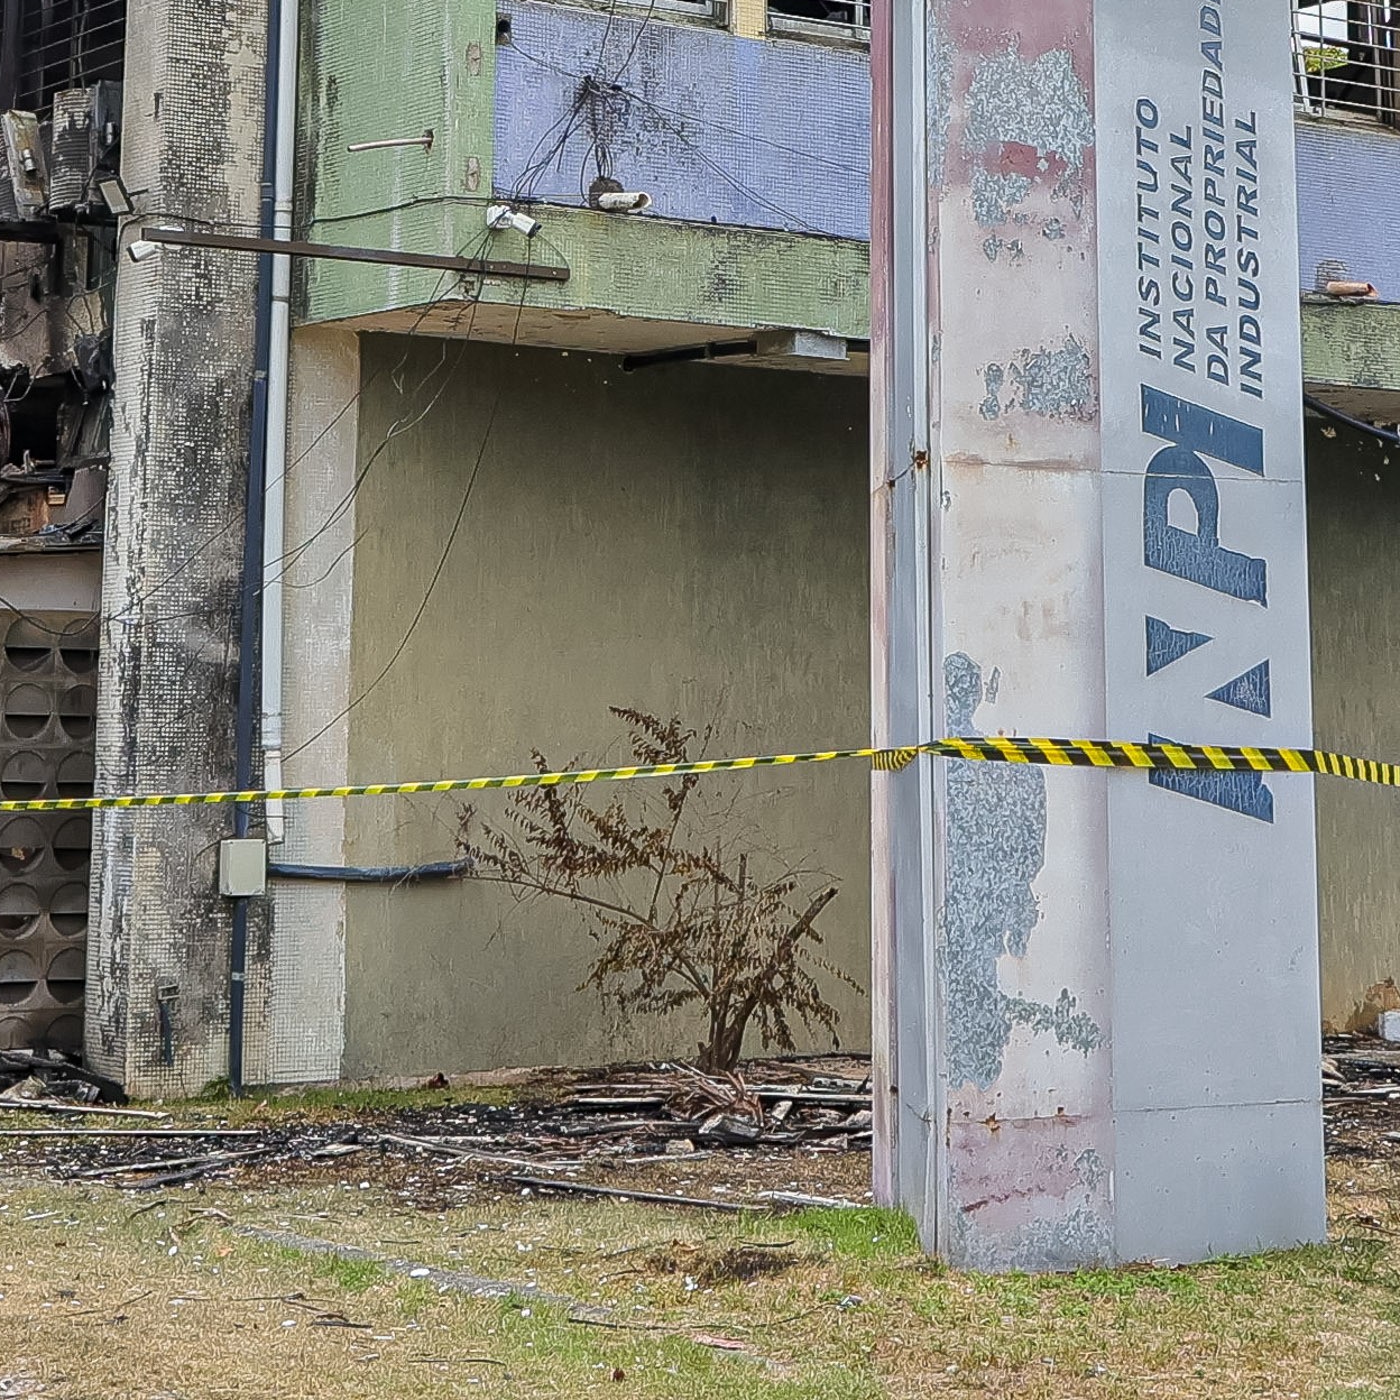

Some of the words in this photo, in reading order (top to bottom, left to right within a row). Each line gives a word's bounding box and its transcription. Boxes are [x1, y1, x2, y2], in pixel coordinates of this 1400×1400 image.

[1136, 98, 1161, 361] INSTITUTO
[1170, 125, 1196, 374] NACIONAL
[1205, 325, 1229, 387] DA
[1235, 110, 1263, 400] INDUSTRIAL
